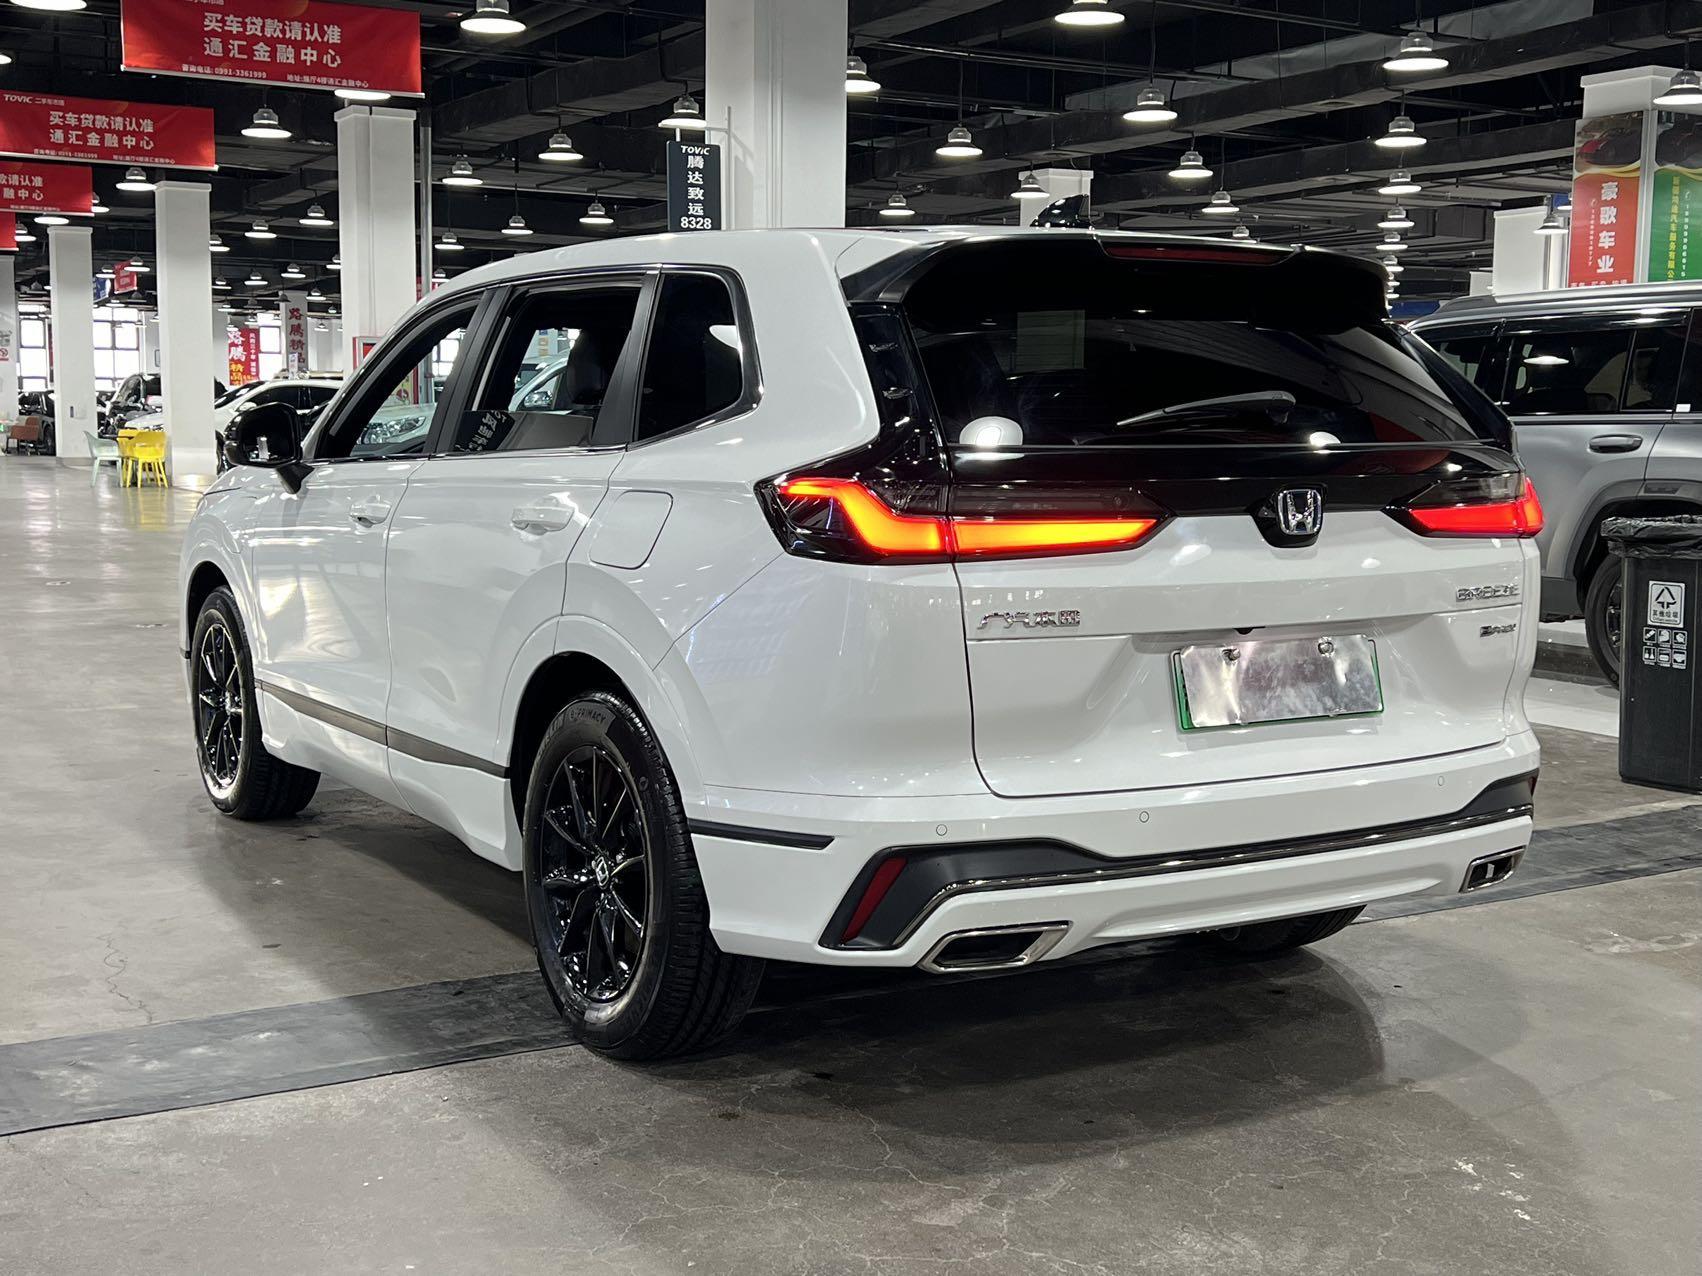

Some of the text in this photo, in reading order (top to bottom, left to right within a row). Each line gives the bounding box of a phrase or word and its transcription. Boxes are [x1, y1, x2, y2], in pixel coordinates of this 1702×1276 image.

[204, 12, 342, 44] 买车贷款请认准
[204, 37, 342, 68] 通汇金融中心
[4, 94, 33, 104] TOVIC
[49, 111, 154, 133] 买车贷款请认准
[49, 129, 154, 150] 通汇金融中心
[680, 145, 711, 155] TOVIC
[687, 155, 704, 216] 腾达致远
[680, 217, 712, 229] 8328
